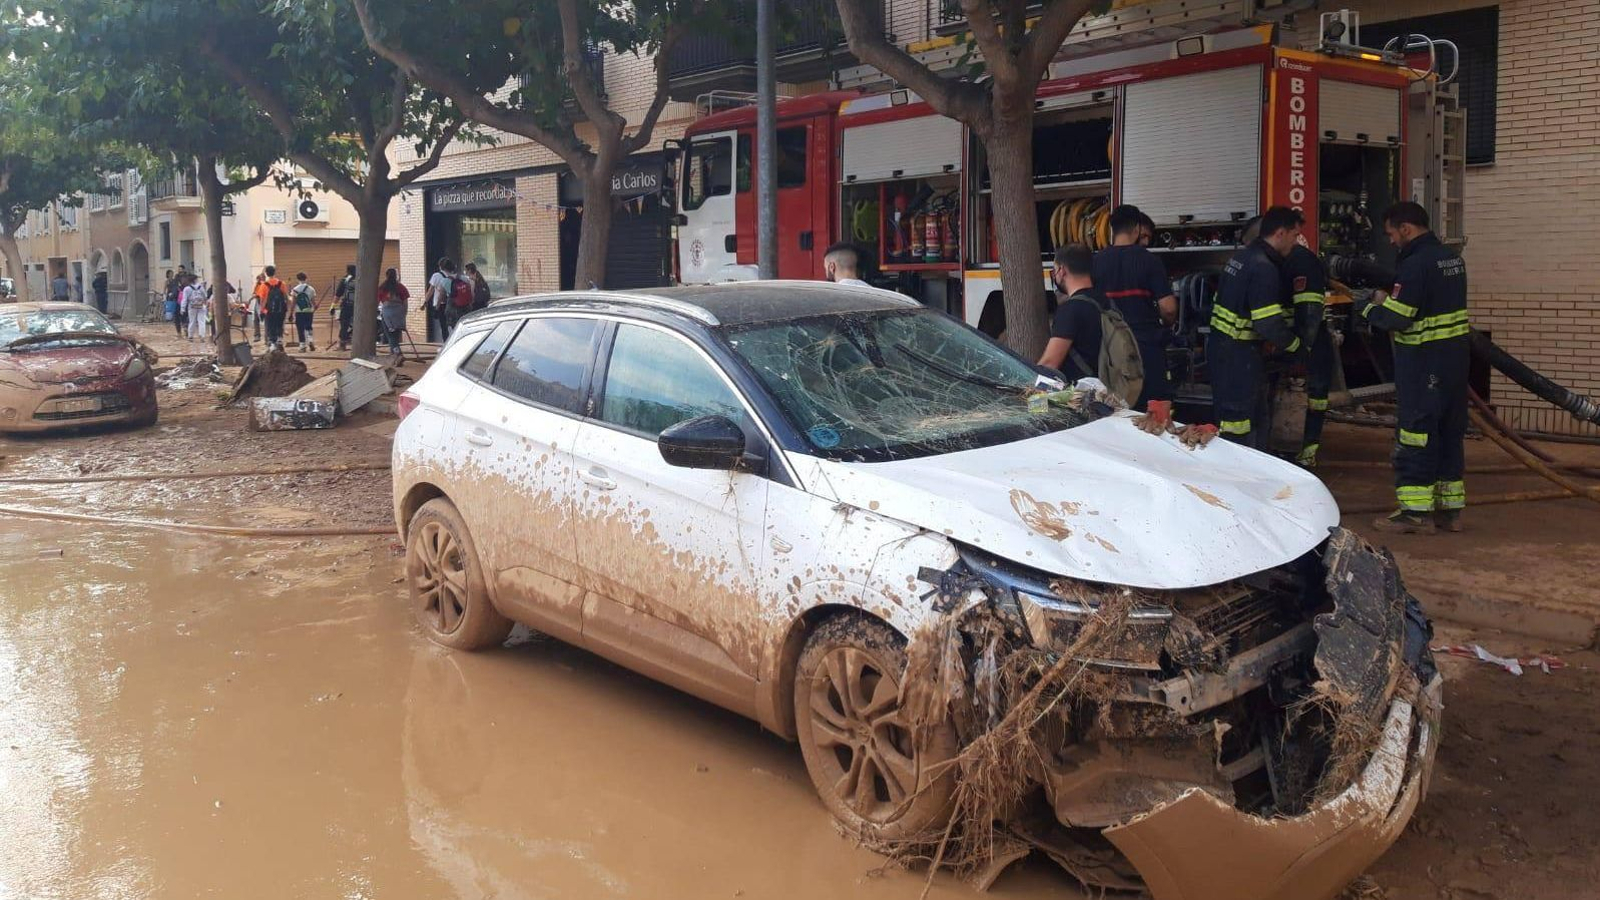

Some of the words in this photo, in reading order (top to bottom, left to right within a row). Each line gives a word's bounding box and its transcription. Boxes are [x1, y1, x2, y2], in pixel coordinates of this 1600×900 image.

[623, 172, 657, 189] Carlos
[434, 192, 443, 205] La
[443, 191, 461, 207] pizza
[461, 191, 475, 205] que
